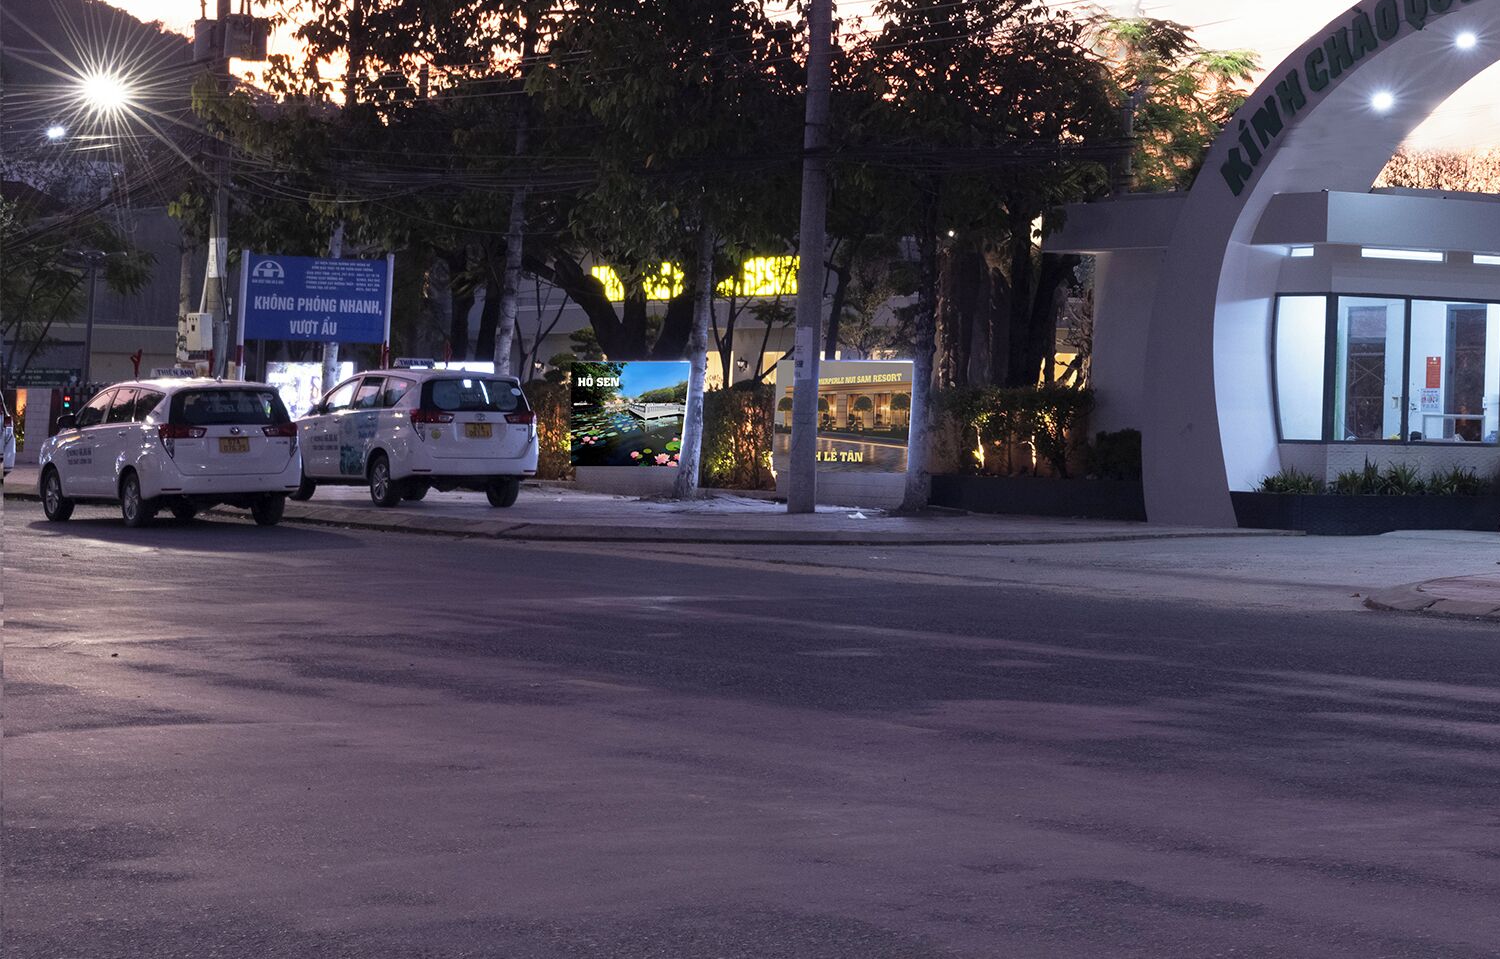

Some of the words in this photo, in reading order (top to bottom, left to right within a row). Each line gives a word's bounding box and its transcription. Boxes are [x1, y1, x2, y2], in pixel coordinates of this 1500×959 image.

[1219, 68, 1306, 198] KÍNH
[1303, 4, 1400, 94] CHÀO
[254, 293, 294, 311] KHÔNG
[297, 295, 337, 312] PHÓNG
[340, 299, 382, 316] NHANH,
[289, 319, 318, 338] VƯỢT
[321, 316, 337, 335] ẨU
[577, 374, 594, 387] HỒ
[596, 376, 620, 387] SEN
[857, 374, 871, 383] SAM
[872, 371, 902, 383] RESORT
[840, 449, 863, 462] TÂN
